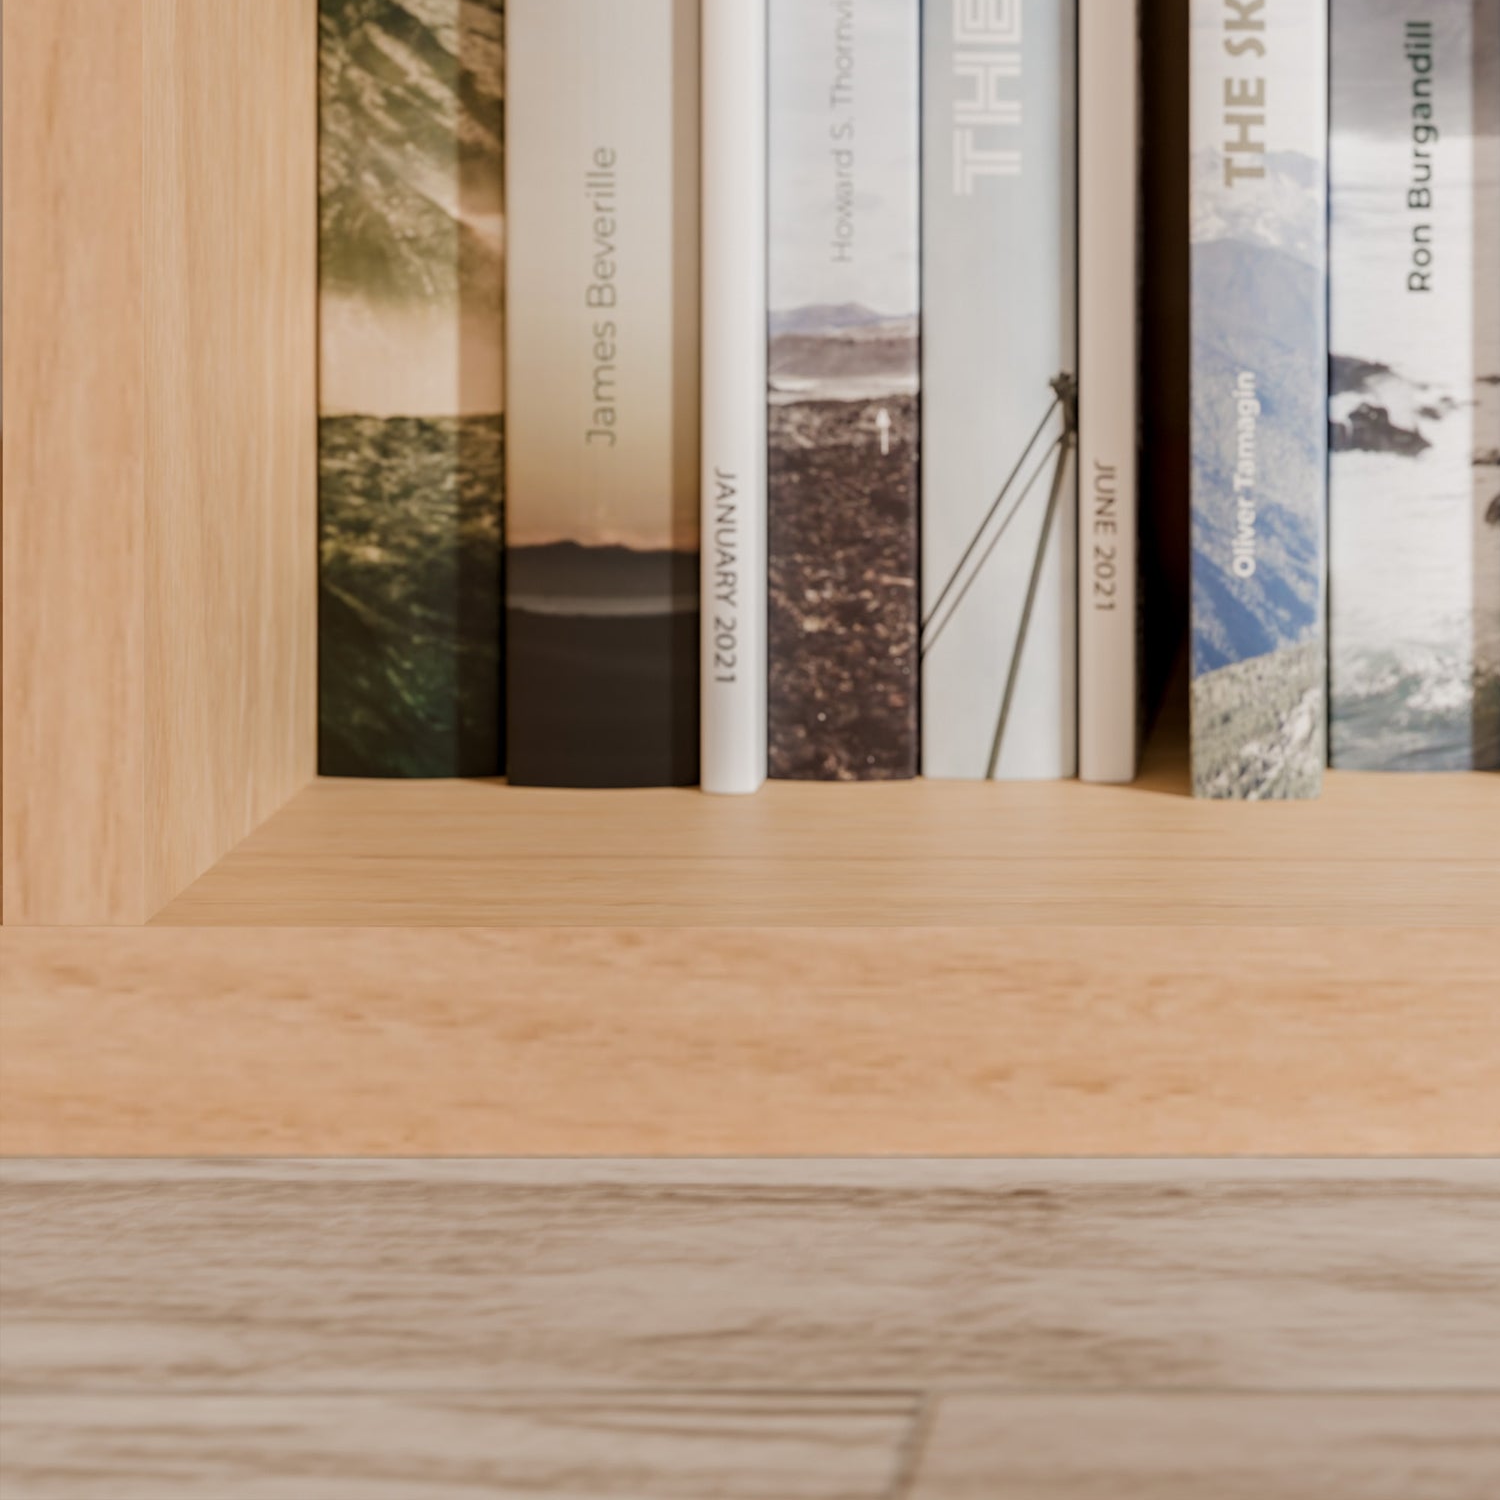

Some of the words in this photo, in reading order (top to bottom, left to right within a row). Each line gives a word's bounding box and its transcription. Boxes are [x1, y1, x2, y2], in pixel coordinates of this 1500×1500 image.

[831, 116, 856, 142] S.
[1223, 77, 1266, 188] THE
[1404, 21, 1437, 209] Burgandill
[585, 146, 617, 309] Beverille
[830, 149, 853, 264] Howard
[1407, 224, 1431, 293] Ron
[585, 320, 617, 448] James
[714, 467, 736, 607] JANUARY
[1094, 460, 1116, 534] JUNE
[1231, 497, 1257, 578] Oliver
[1094, 545, 1116, 612] 2021
[714, 616, 736, 684] 2021
